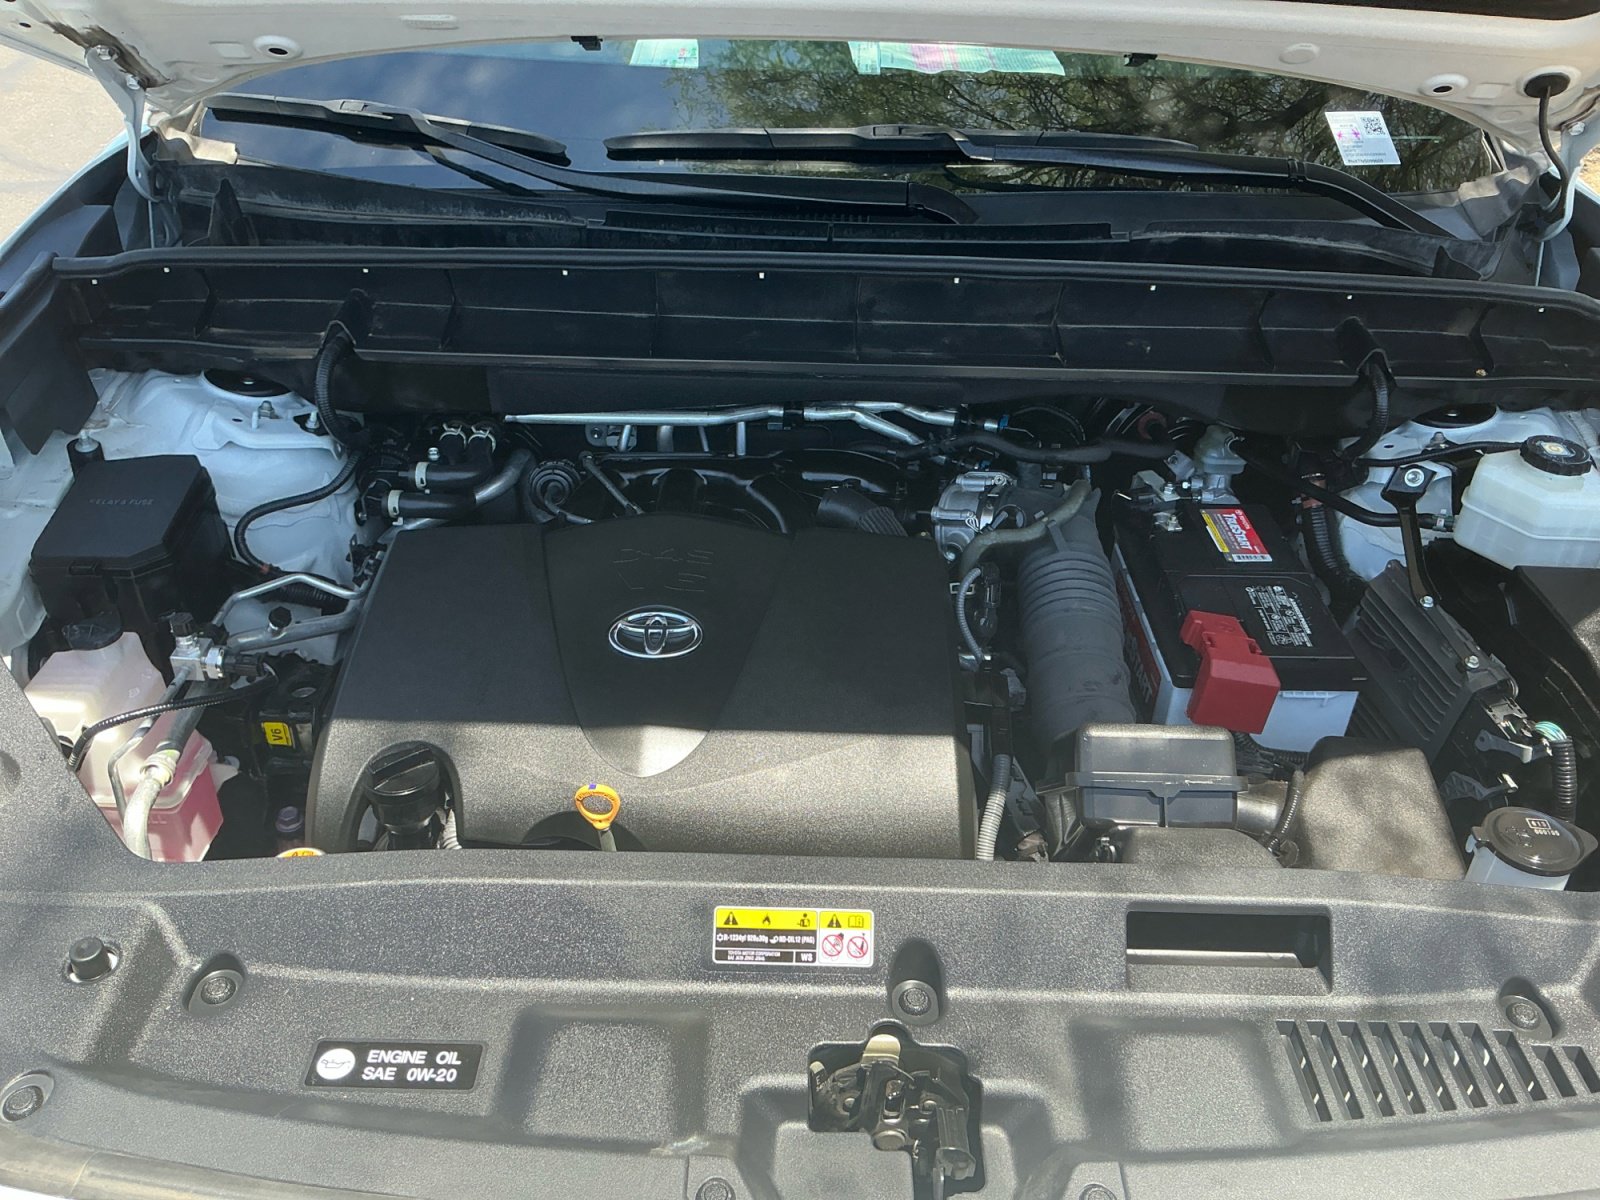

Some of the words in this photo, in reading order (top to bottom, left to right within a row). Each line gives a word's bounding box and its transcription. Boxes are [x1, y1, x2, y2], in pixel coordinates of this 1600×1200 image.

[366, 1049, 428, 1064] ENGINE
[435, 1051, 462, 1065] OIL
[361, 1066, 397, 1080] SAE
[406, 1067, 458, 1082] 0W-20
